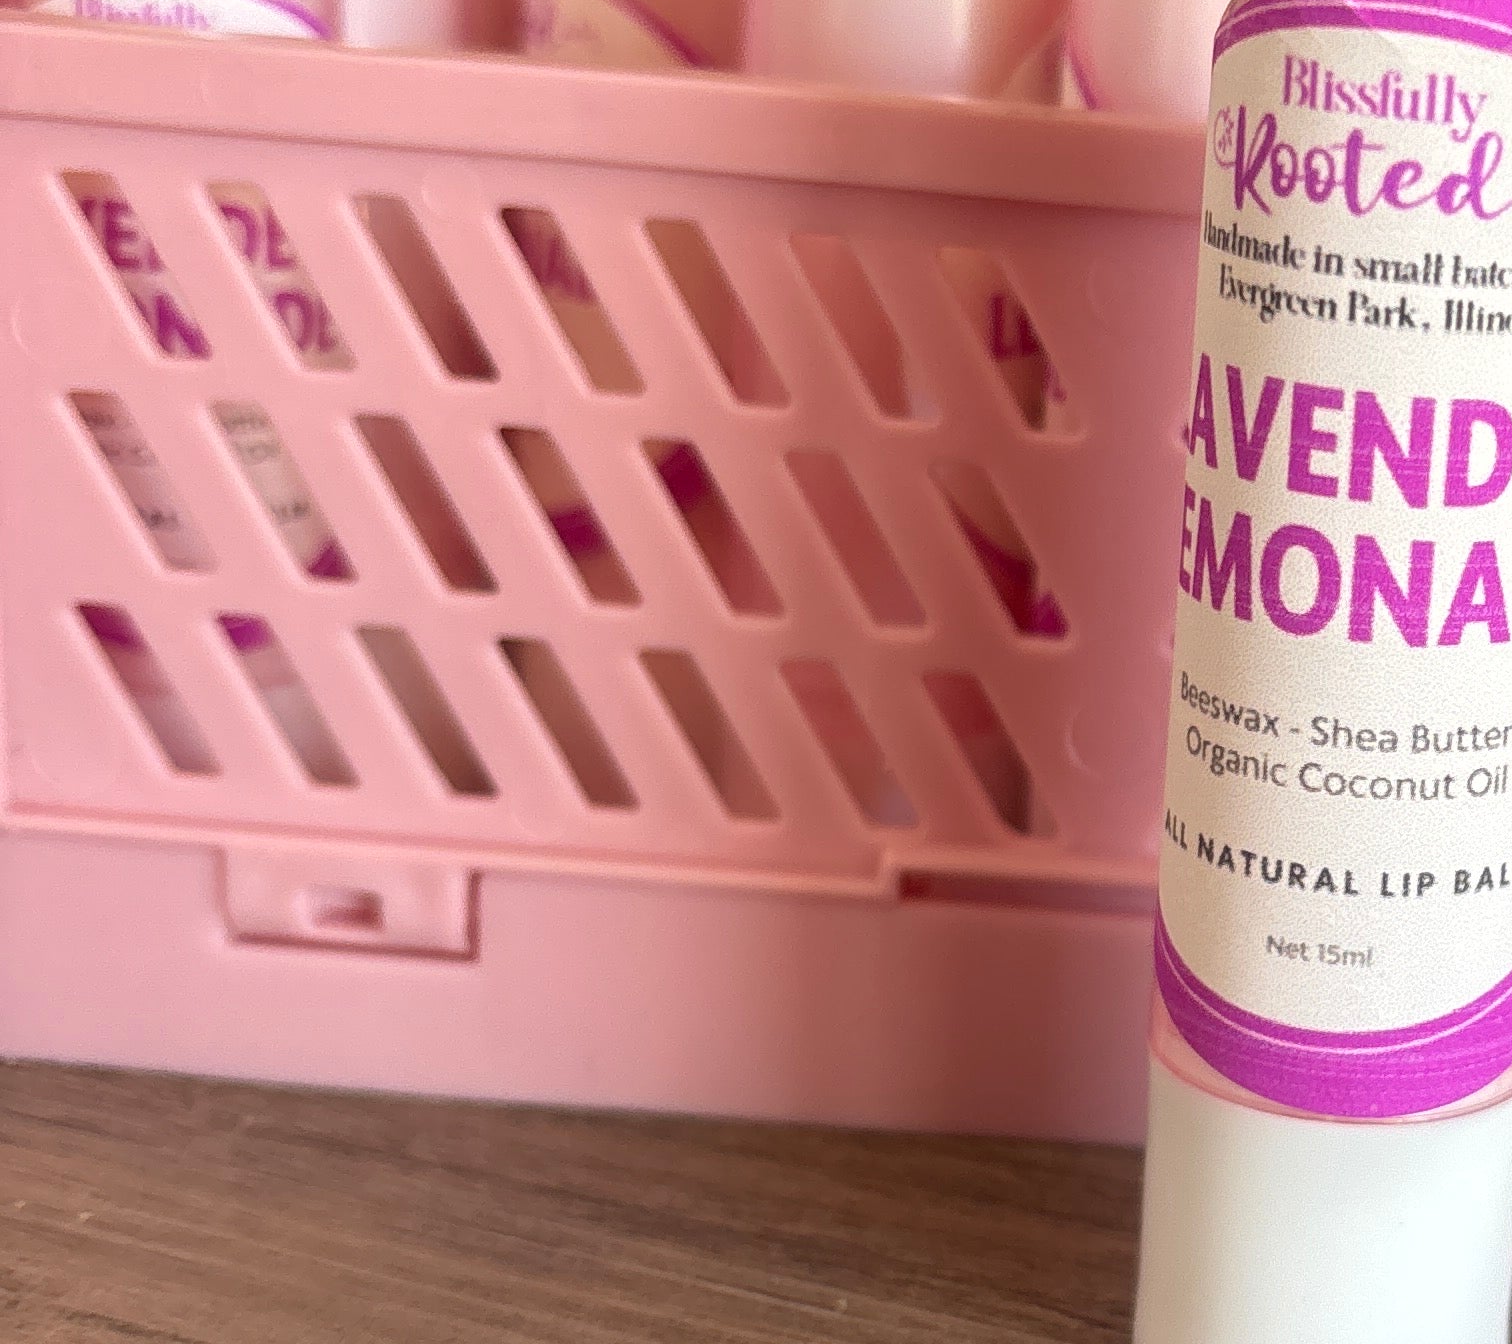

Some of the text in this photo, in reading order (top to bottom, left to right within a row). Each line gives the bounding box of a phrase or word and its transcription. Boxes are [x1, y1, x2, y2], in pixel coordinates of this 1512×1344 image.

[1280, 53, 1485, 142] Blissfully
[1234, 103, 1504, 221] Rooted
[1204, 210, 1305, 269] Handmade
[1312, 245, 1344, 276] in
[1353, 252, 1443, 286] small
[1219, 262, 1337, 324] Evergreen
[1347, 289, 1431, 333] Park,
[1181, 671, 1280, 737] Beeswax
[1309, 716, 1398, 754] Shea
[1186, 725, 1508, 801] Organic Coconut Oil
[1165, 809, 1187, 850] ALL
[1197, 832, 1360, 896] NATURAL
[1380, 871, 1436, 898] LIP
[1266, 934, 1375, 968] Net 15ml
